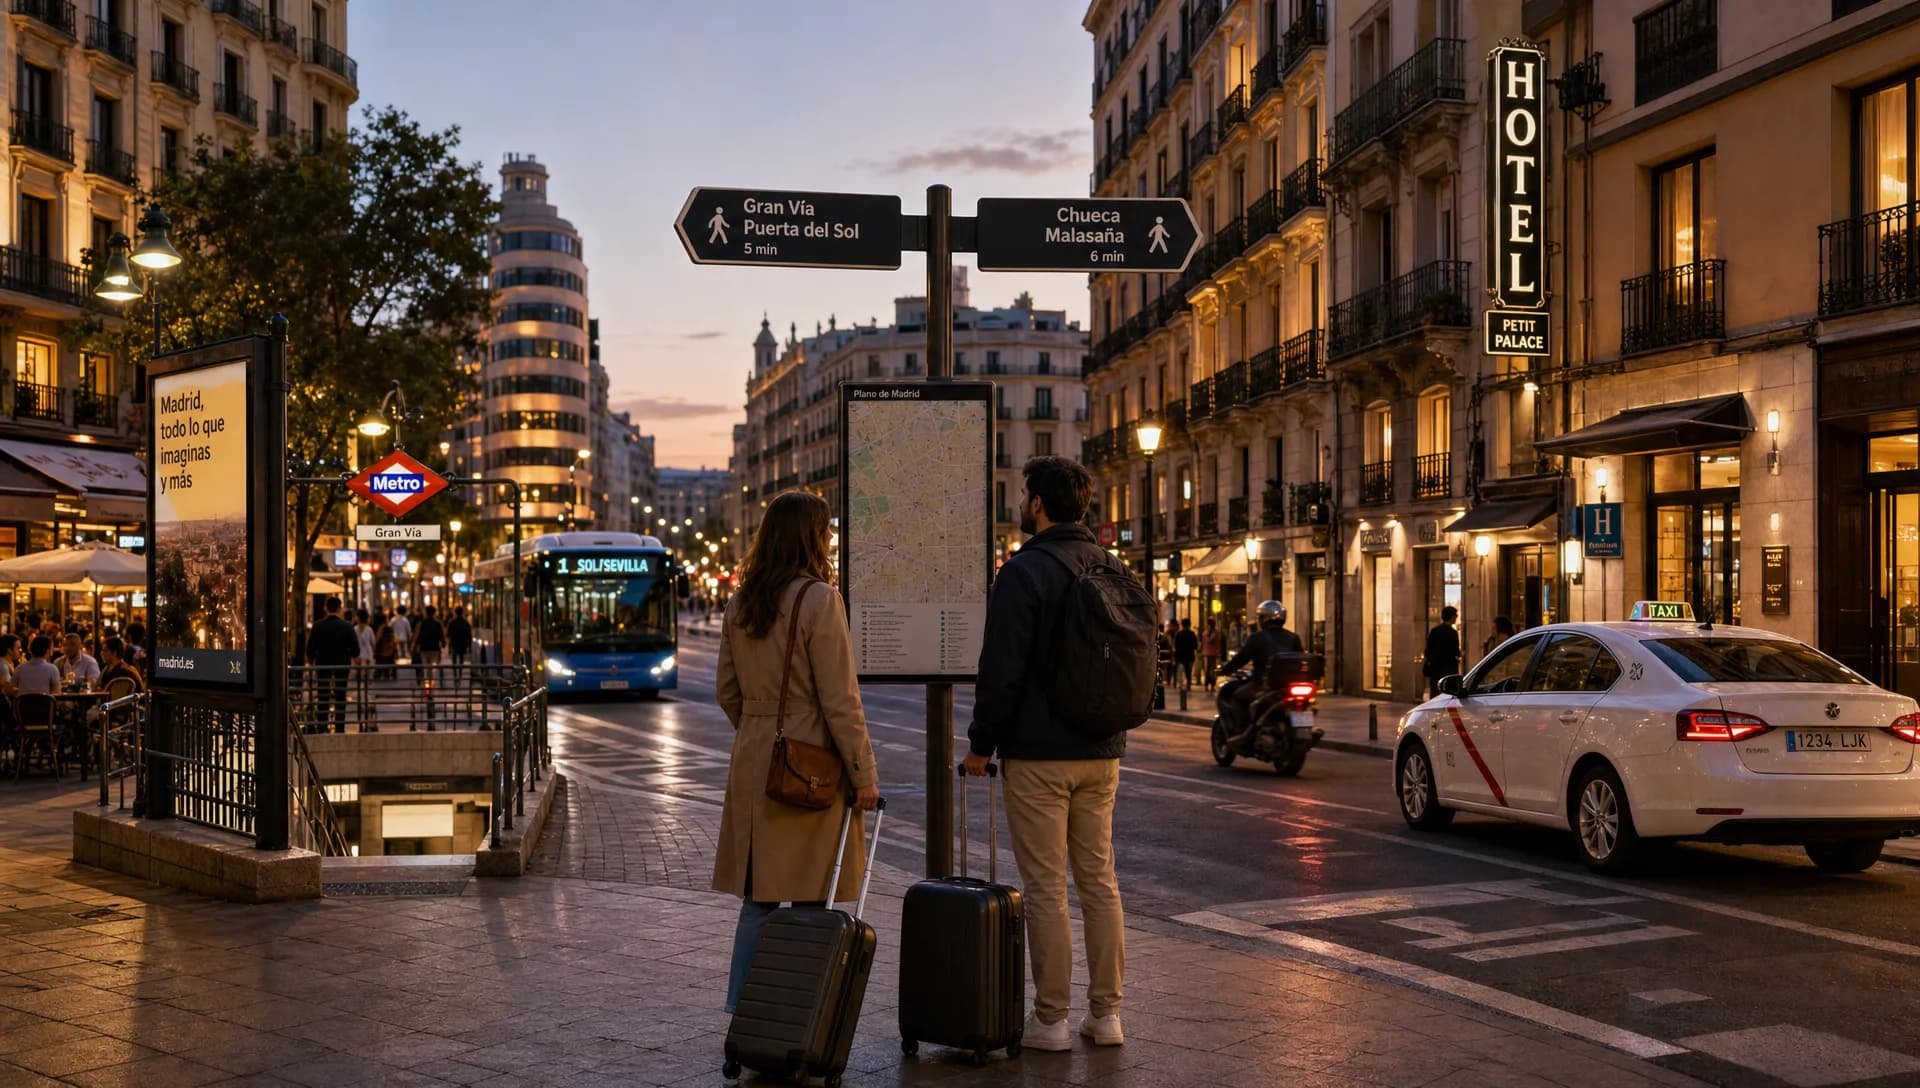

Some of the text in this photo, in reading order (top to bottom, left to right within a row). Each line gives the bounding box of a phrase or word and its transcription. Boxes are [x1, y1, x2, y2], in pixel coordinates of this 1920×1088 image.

[1505, 60, 1537, 293] HOTEL
[743, 198, 815, 217] Gran Vía
[1056, 206, 1121, 223] Chueca
[744, 219, 859, 240] Puerta del Sol
[744, 242, 778, 256] 5 min
[1090, 250, 1125, 263] 6 min
[1503, 319, 1536, 333] PETIT
[1495, 334, 1544, 349] PALACE
[160, 389, 204, 415] Madrid,
[853, 389, 920, 399] Plano de Madrid
[160, 416, 225, 440] todo lo que
[160, 443, 211, 468] imaginas
[160, 469, 193, 495] y más
[372, 476, 421, 491] Metro
[1593, 507, 1613, 536] H
[375, 527, 422, 538] Gran Vía
[557, 558, 649, 574] 1 SOL/SEVILLA
[1650, 605, 1678, 617] TAXI
[159, 656, 194, 669] madrid.es
[1797, 733, 1867, 749] 1234 LJK
